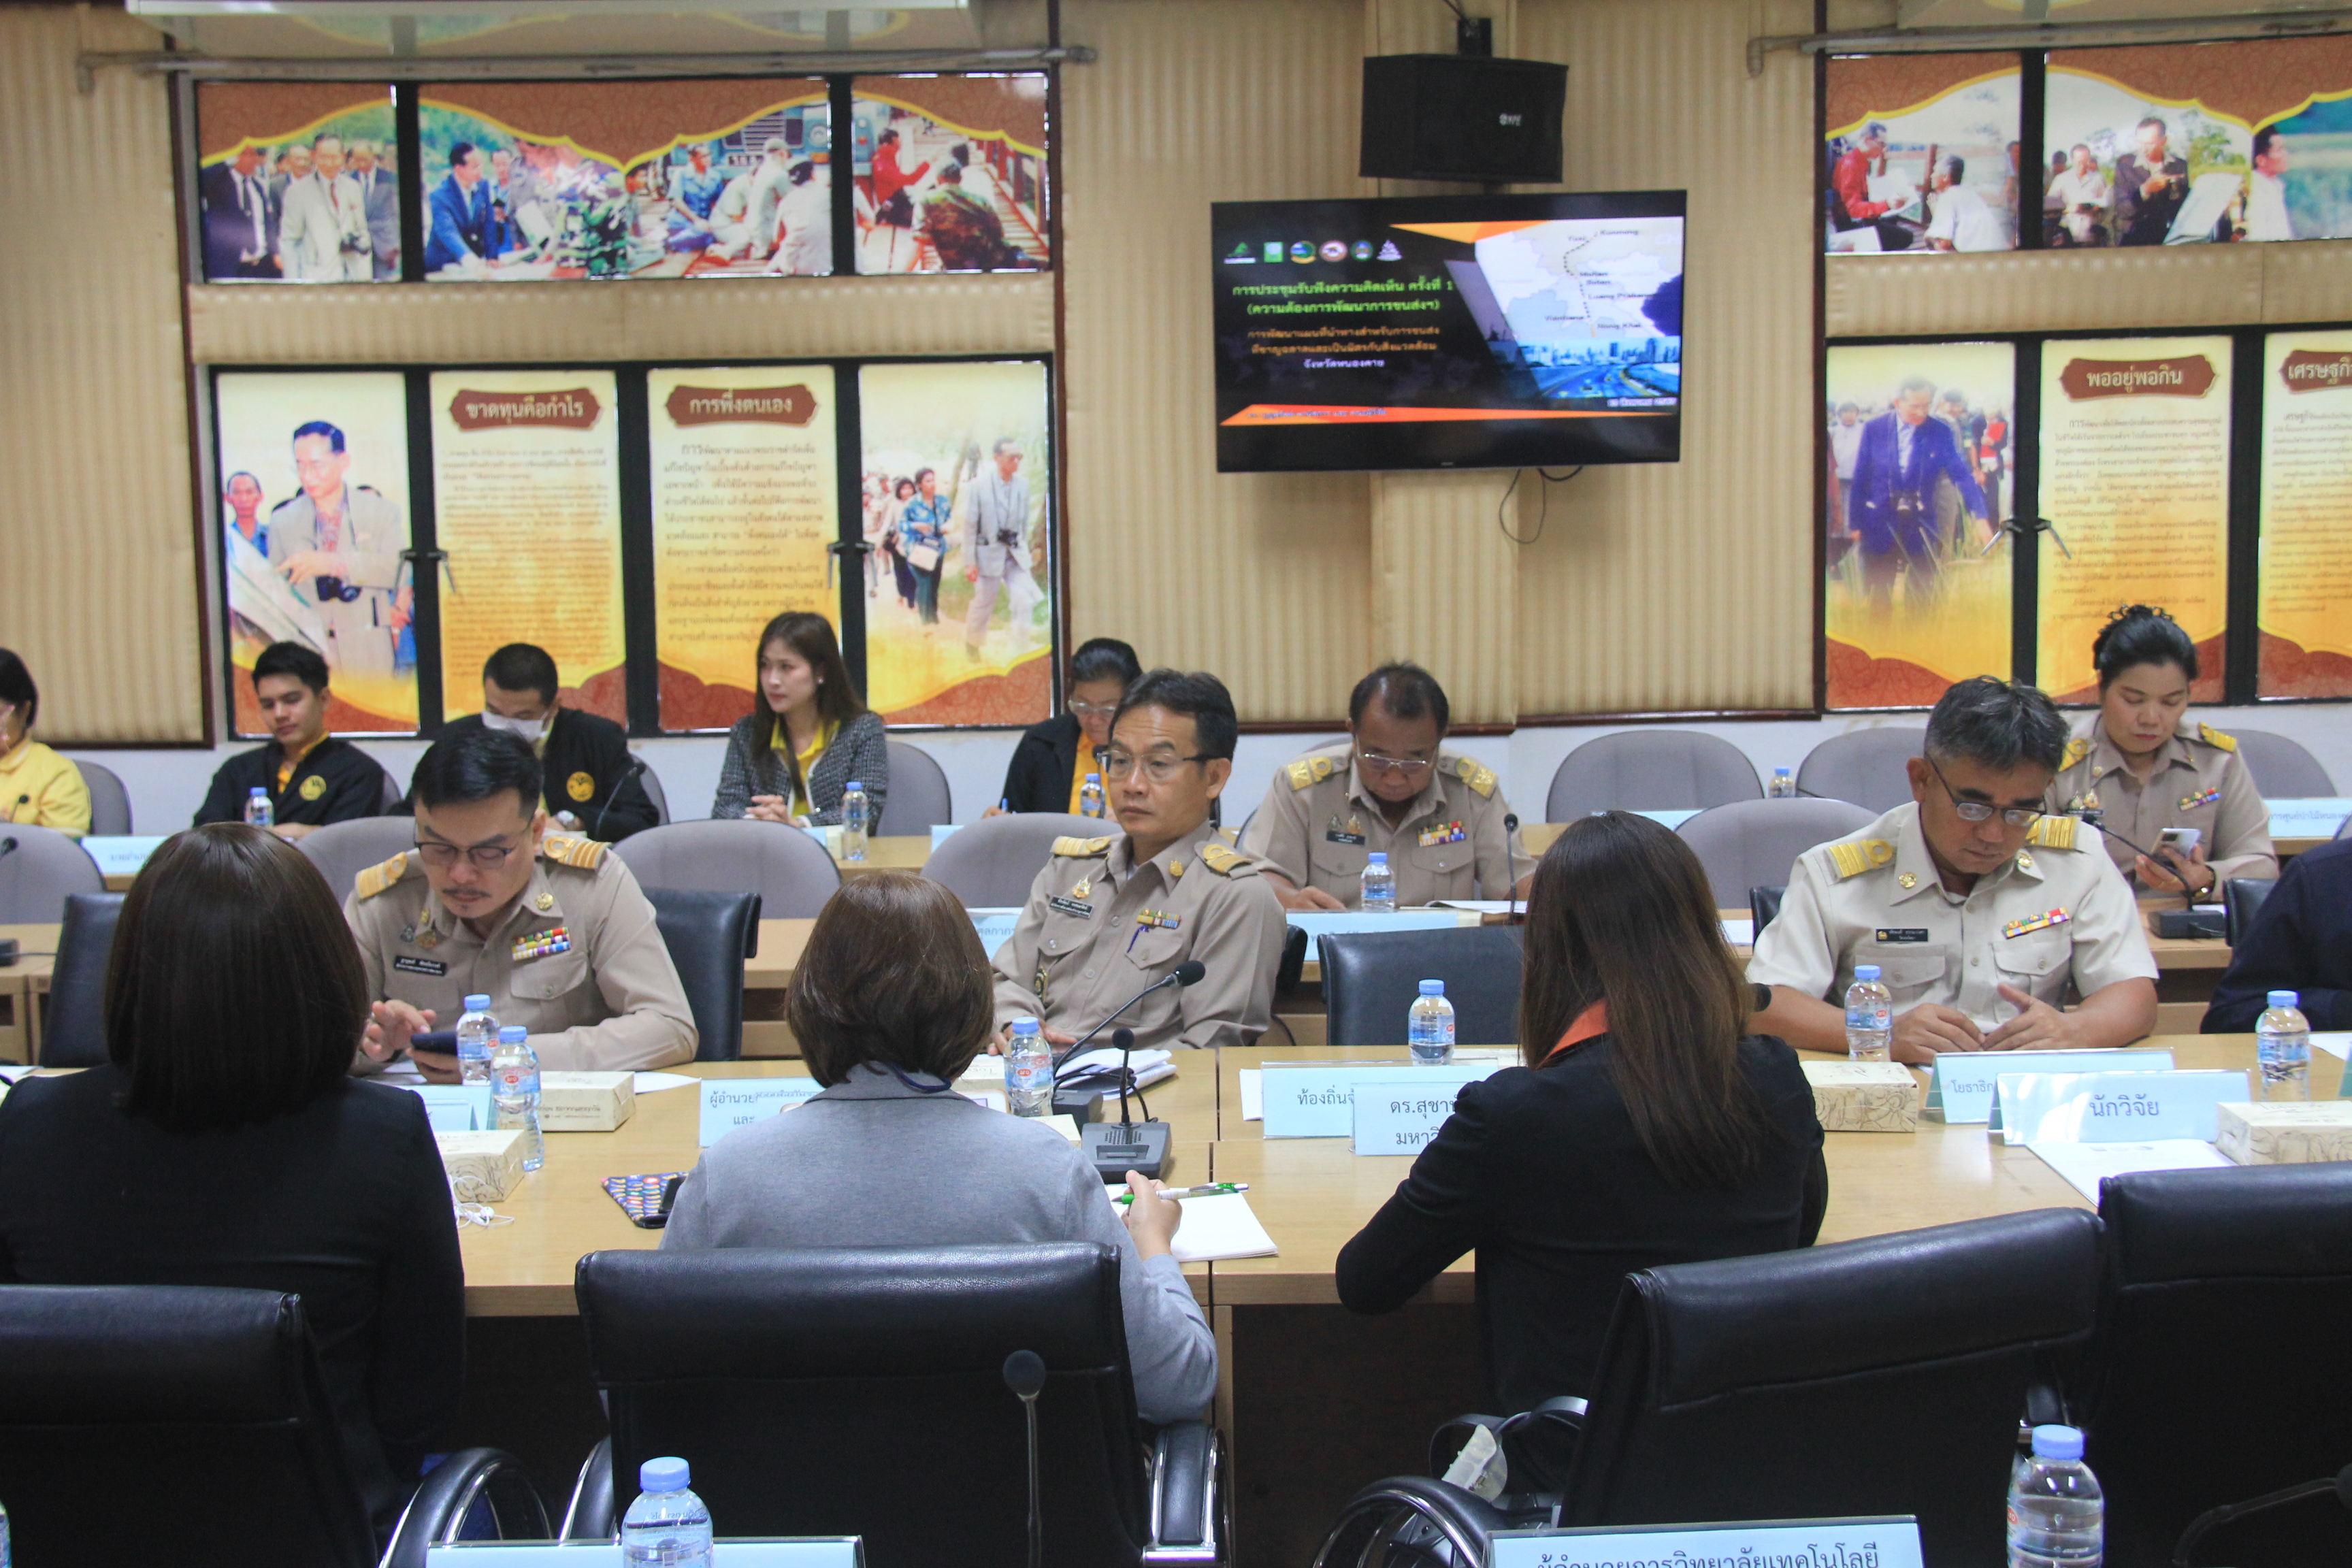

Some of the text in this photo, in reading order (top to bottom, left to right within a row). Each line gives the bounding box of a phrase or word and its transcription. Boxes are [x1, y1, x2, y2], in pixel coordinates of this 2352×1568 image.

[1232, 275, 1453, 297] การประชุมรับฟังความคิดเห็น ครั้งที่ 1
[1247, 299, 1441, 315] (ความต้องการพัฒนาการขนส่งฯ)
[1303, 358, 1385, 368] จังหวัดหนองคาย
[2288, 356, 2352, 386] เศรษฐกิ
[2087, 363, 2183, 393] พออยู่พอกิน
[466, 394, 584, 425] ขาดทุนคือกำไร
[689, 388, 793, 414] การพึ่งตนเอง
[2089, 1093, 2159, 1116] นักวิจัย
[733, 1115, 755, 1125] และ
[1538, 1540, 1878, 1568] ้รวิทยาลัยเทคโนโลยี
